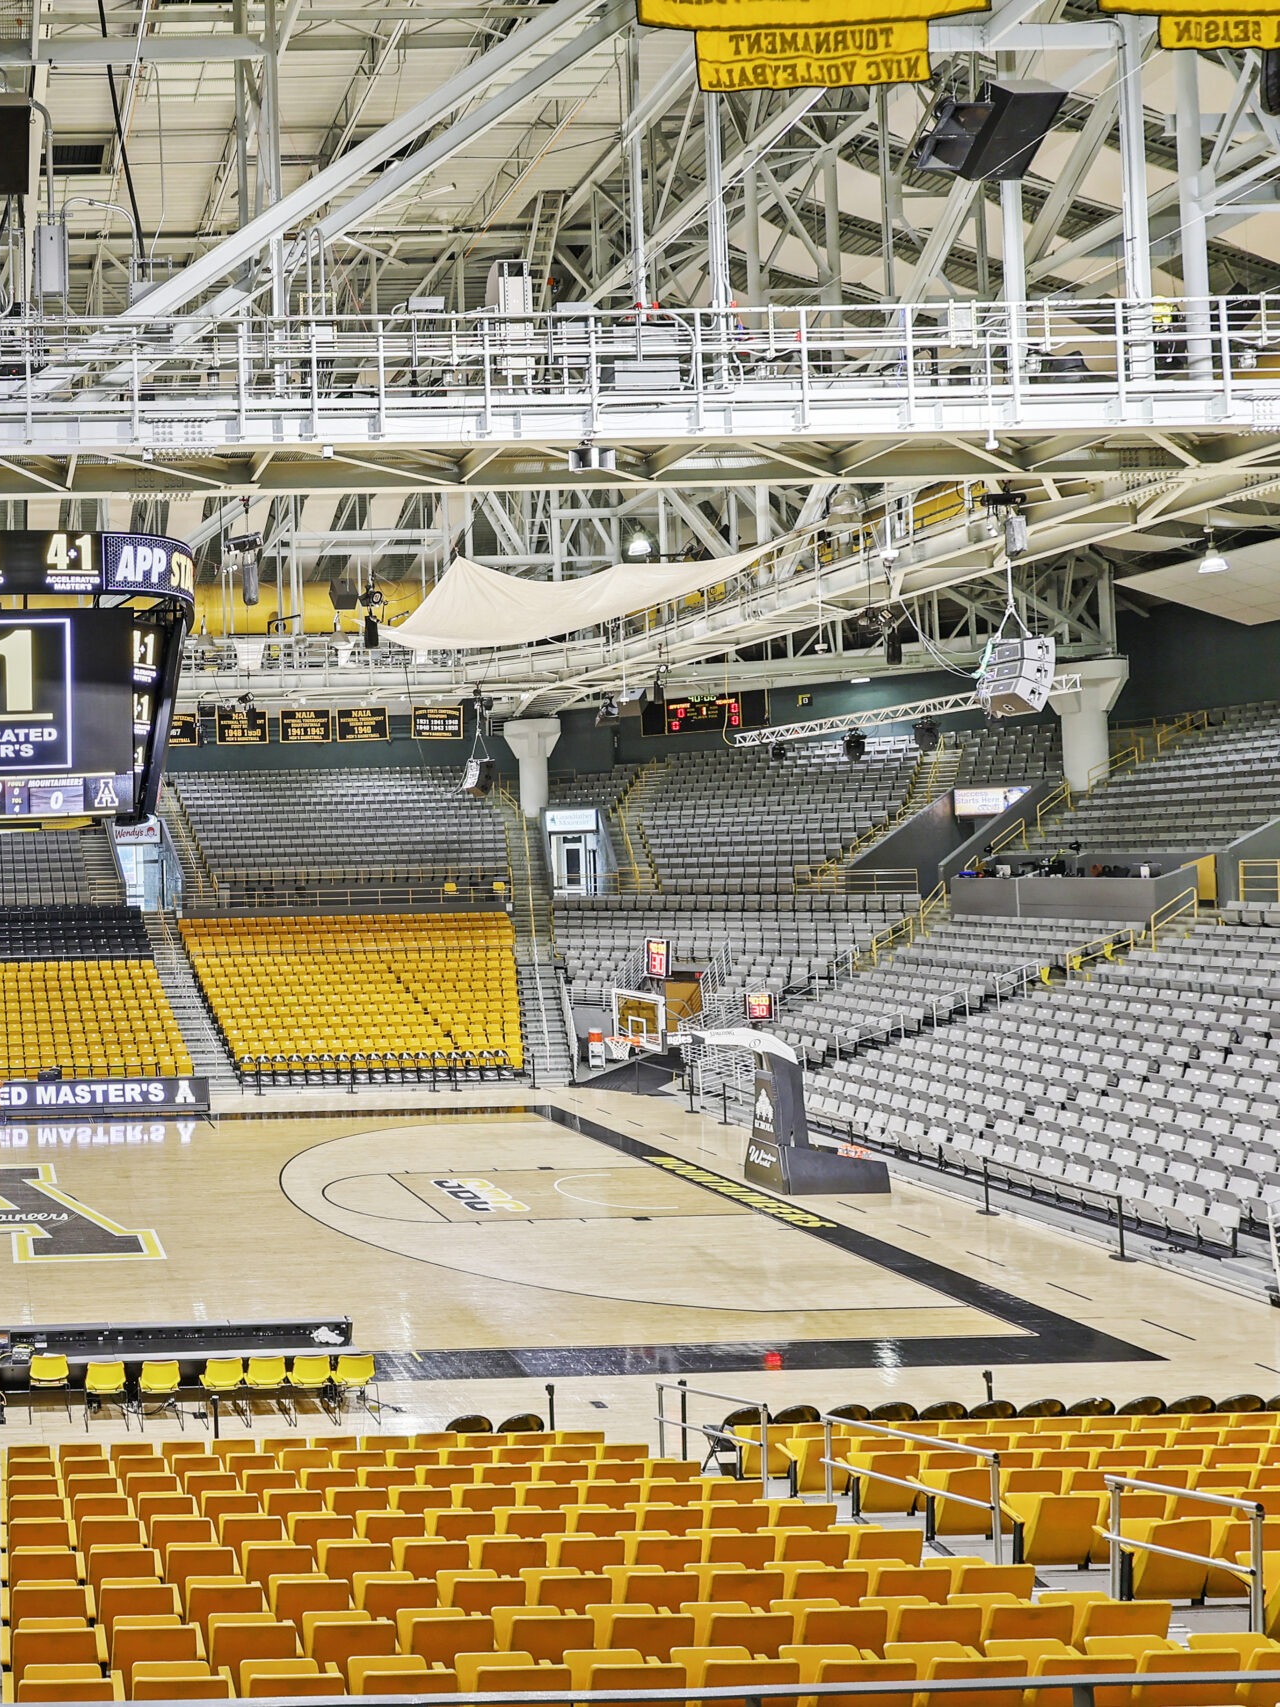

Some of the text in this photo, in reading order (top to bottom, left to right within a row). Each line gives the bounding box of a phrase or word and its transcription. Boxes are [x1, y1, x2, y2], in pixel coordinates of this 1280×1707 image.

[115, 545, 167, 583] APP
[46, 576, 100, 584] ACCELERATED
[54, 583, 93, 591] MASTER'S
[295, 711, 316, 719] NAIA
[352, 709, 372, 718] NAIA
[28, 777, 84, 788] MOUNTAINEERS
[13, 788, 19, 796] 0
[50, 791, 64, 810] 0
[13, 804, 20, 813] 4
[115, 828, 144, 840] Wendy's
[651, 954, 664, 973] 30
[752, 1006, 767, 1016] 30
[667, 1034, 693, 1046] ngles
[36, 1082, 165, 1105] MASTER'S
[642, 1156, 839, 1229] MOUNTAINEERS
